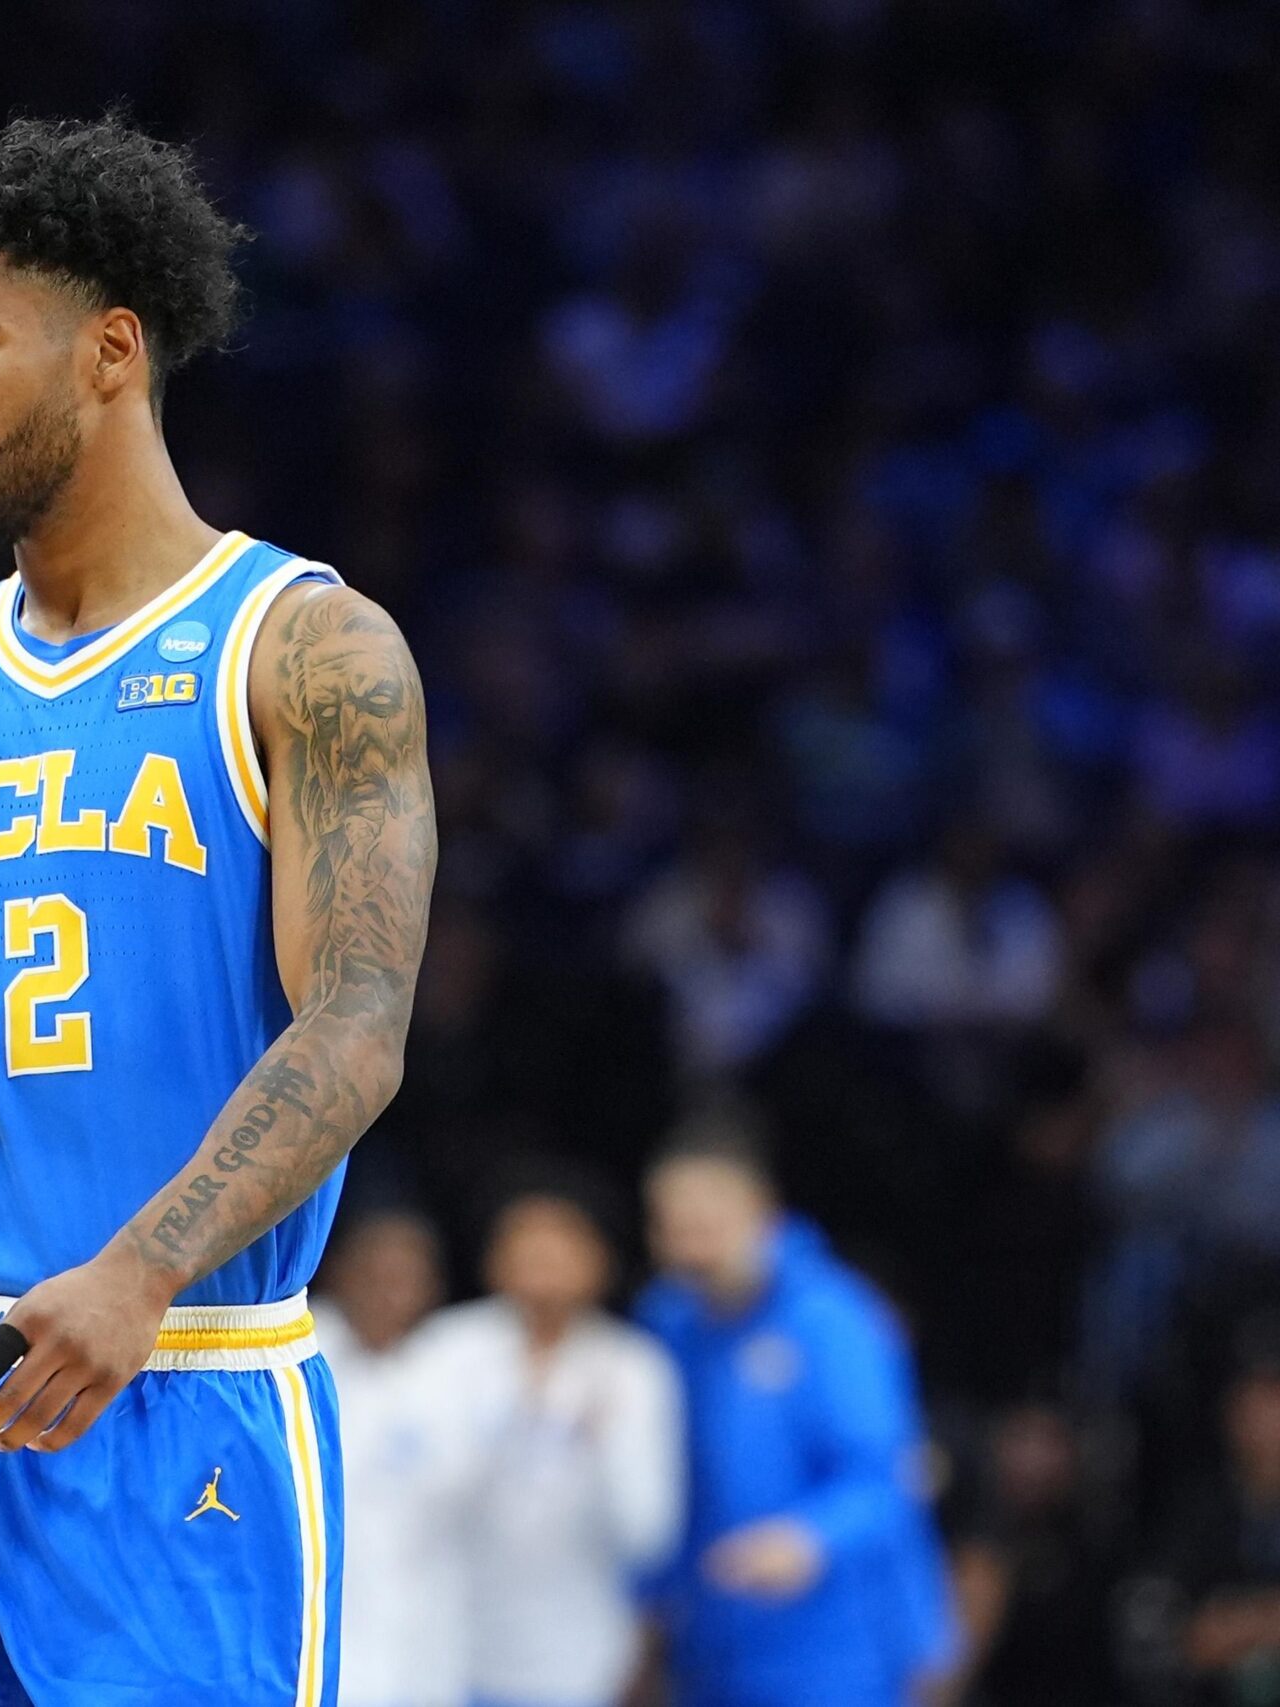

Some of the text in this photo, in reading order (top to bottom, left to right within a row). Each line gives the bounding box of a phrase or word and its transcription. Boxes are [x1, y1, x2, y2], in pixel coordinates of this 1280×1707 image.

[161, 637, 206, 654] NCAA
[4, 893, 93, 1078] 2
[150, 1103, 278, 1253] FEAR GOD
